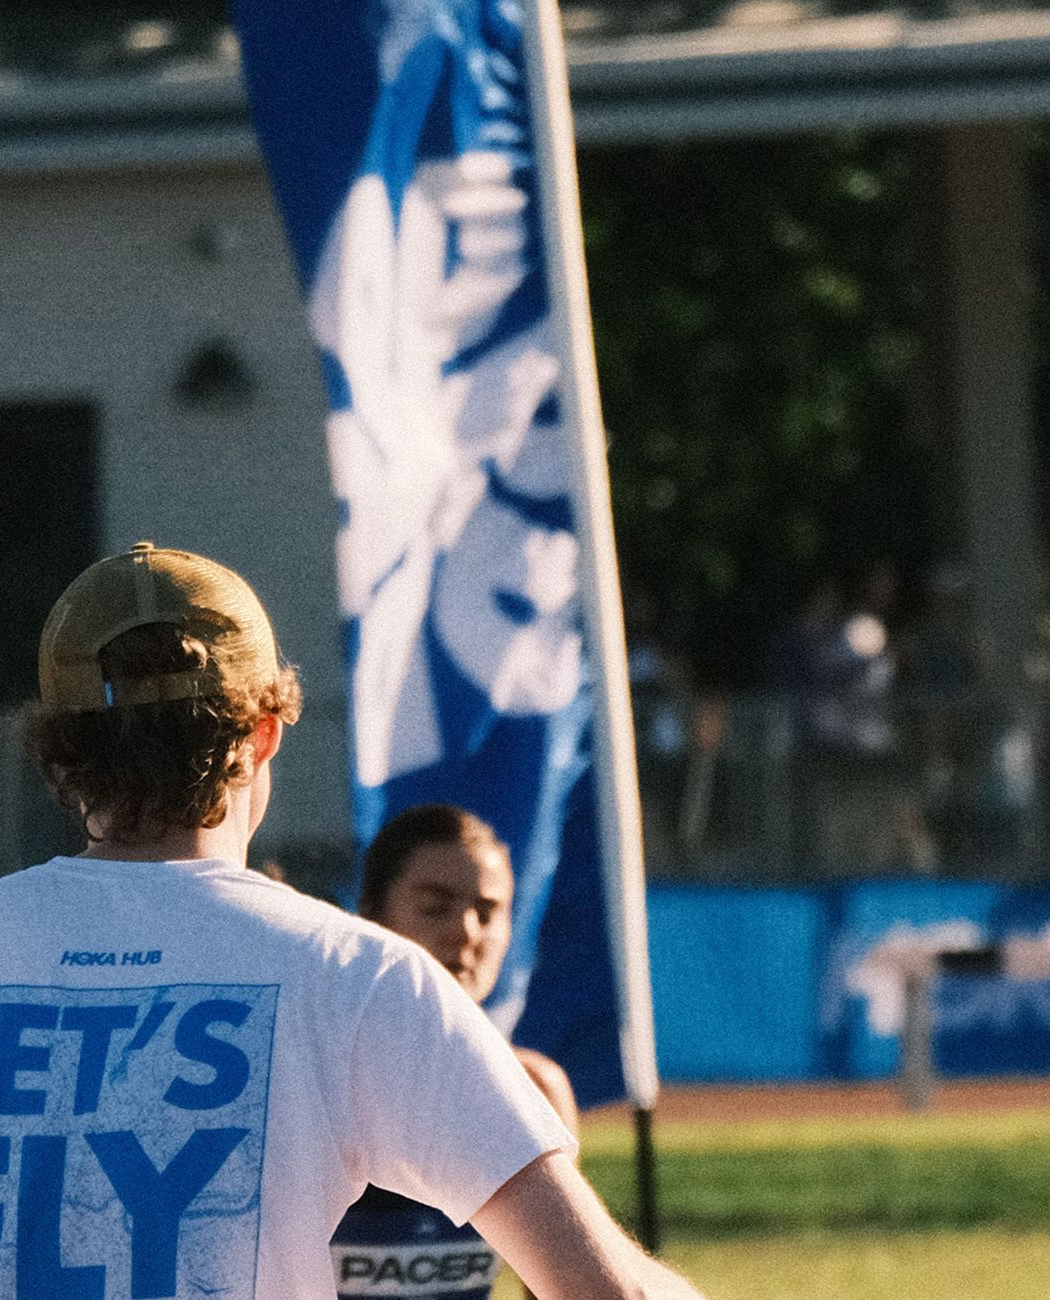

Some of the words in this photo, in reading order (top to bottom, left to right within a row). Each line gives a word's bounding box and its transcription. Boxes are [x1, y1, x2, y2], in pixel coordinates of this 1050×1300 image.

[60, 950, 116, 966] HOKA
[121, 950, 163, 966] HUB
[341, 1252, 494, 1284] PACER
